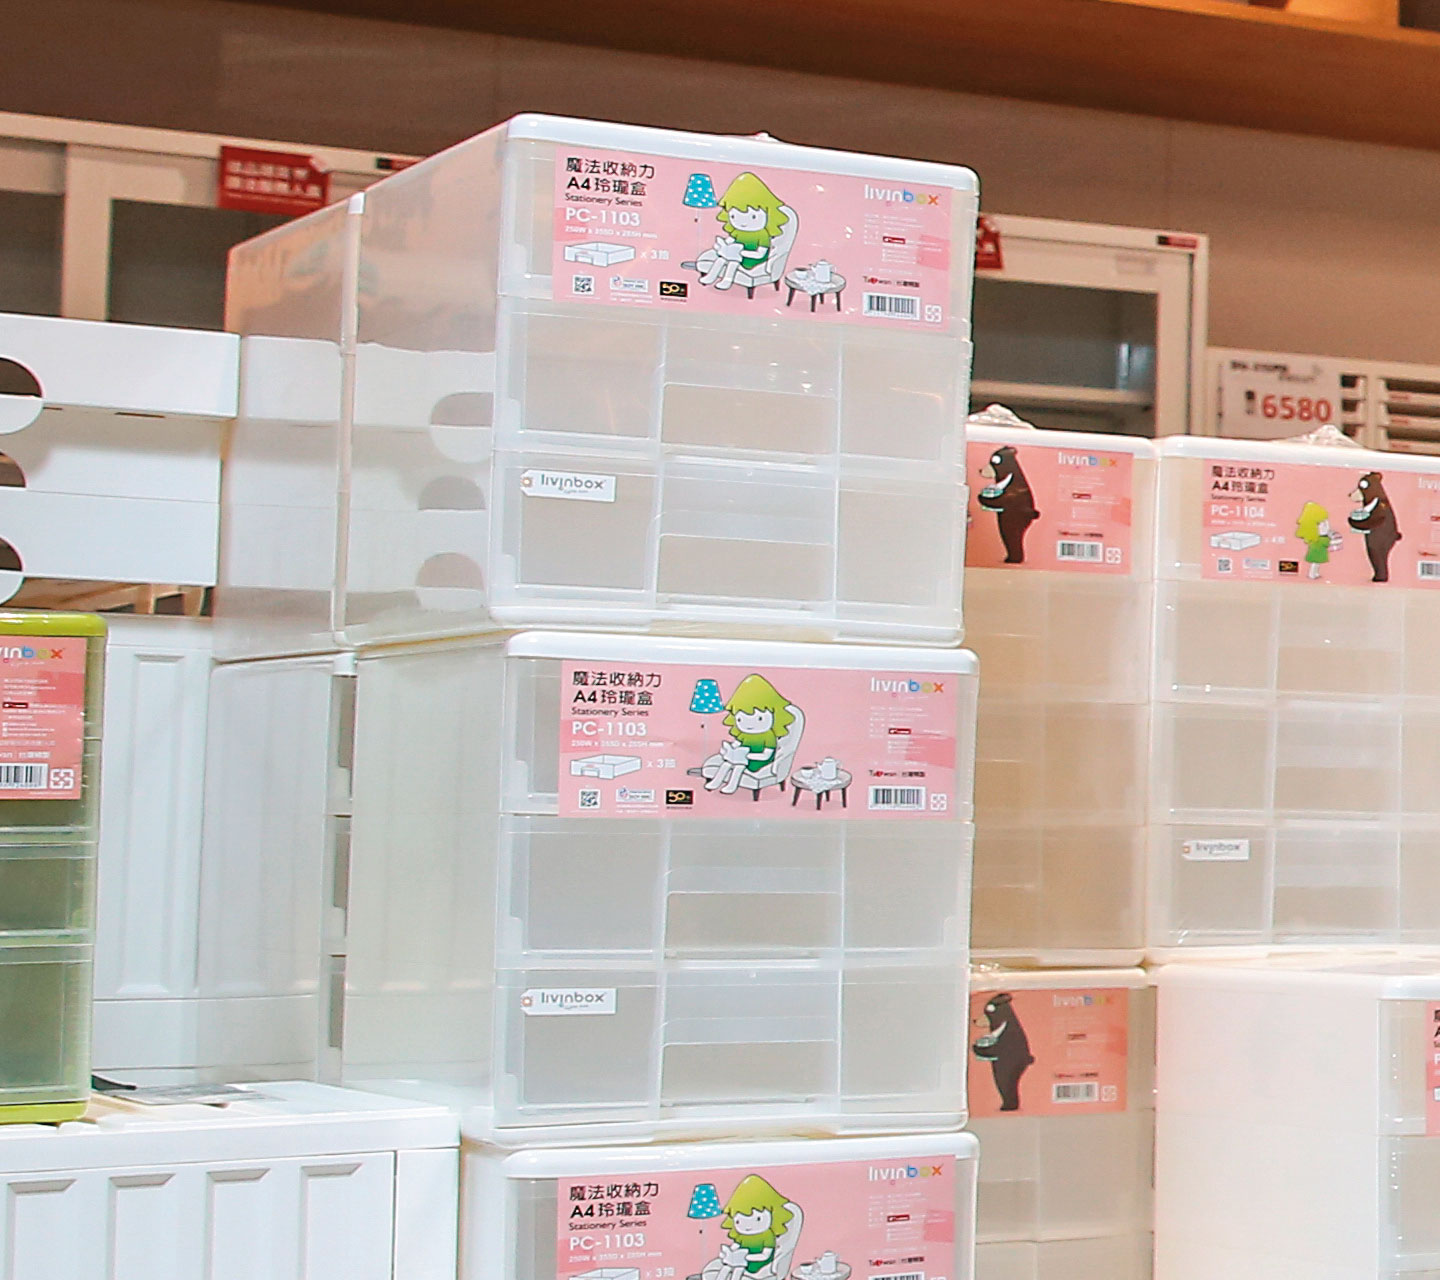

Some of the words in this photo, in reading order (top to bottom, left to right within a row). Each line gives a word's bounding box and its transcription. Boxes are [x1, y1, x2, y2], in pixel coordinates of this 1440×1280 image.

[566, 157, 655, 179] 魔法收納力
[565, 192, 612, 207] Stationery
[616, 197, 643, 207] Series
[864, 184, 940, 205] livinbox
[565, 207, 640, 227] PC-1103
[1263, 395, 1332, 422] 6580
[541, 474, 604, 490] livinbox
[1211, 504, 1264, 518] PC-1104
[572, 671, 662, 688] 魔法收納力
[871, 677, 944, 696] livinbox
[571, 707, 618, 718] Stationery
[621, 707, 649, 717] Series
[572, 721, 647, 736] PC-1103
[541, 992, 604, 1007] livinbox
[868, 1164, 943, 1185] livinbox
[569, 1182, 659, 1201] 魔法收納力
[568, 1221, 616, 1231] Stationery
[619, 1219, 647, 1228] Series
[569, 1233, 645, 1251] PC-1103
